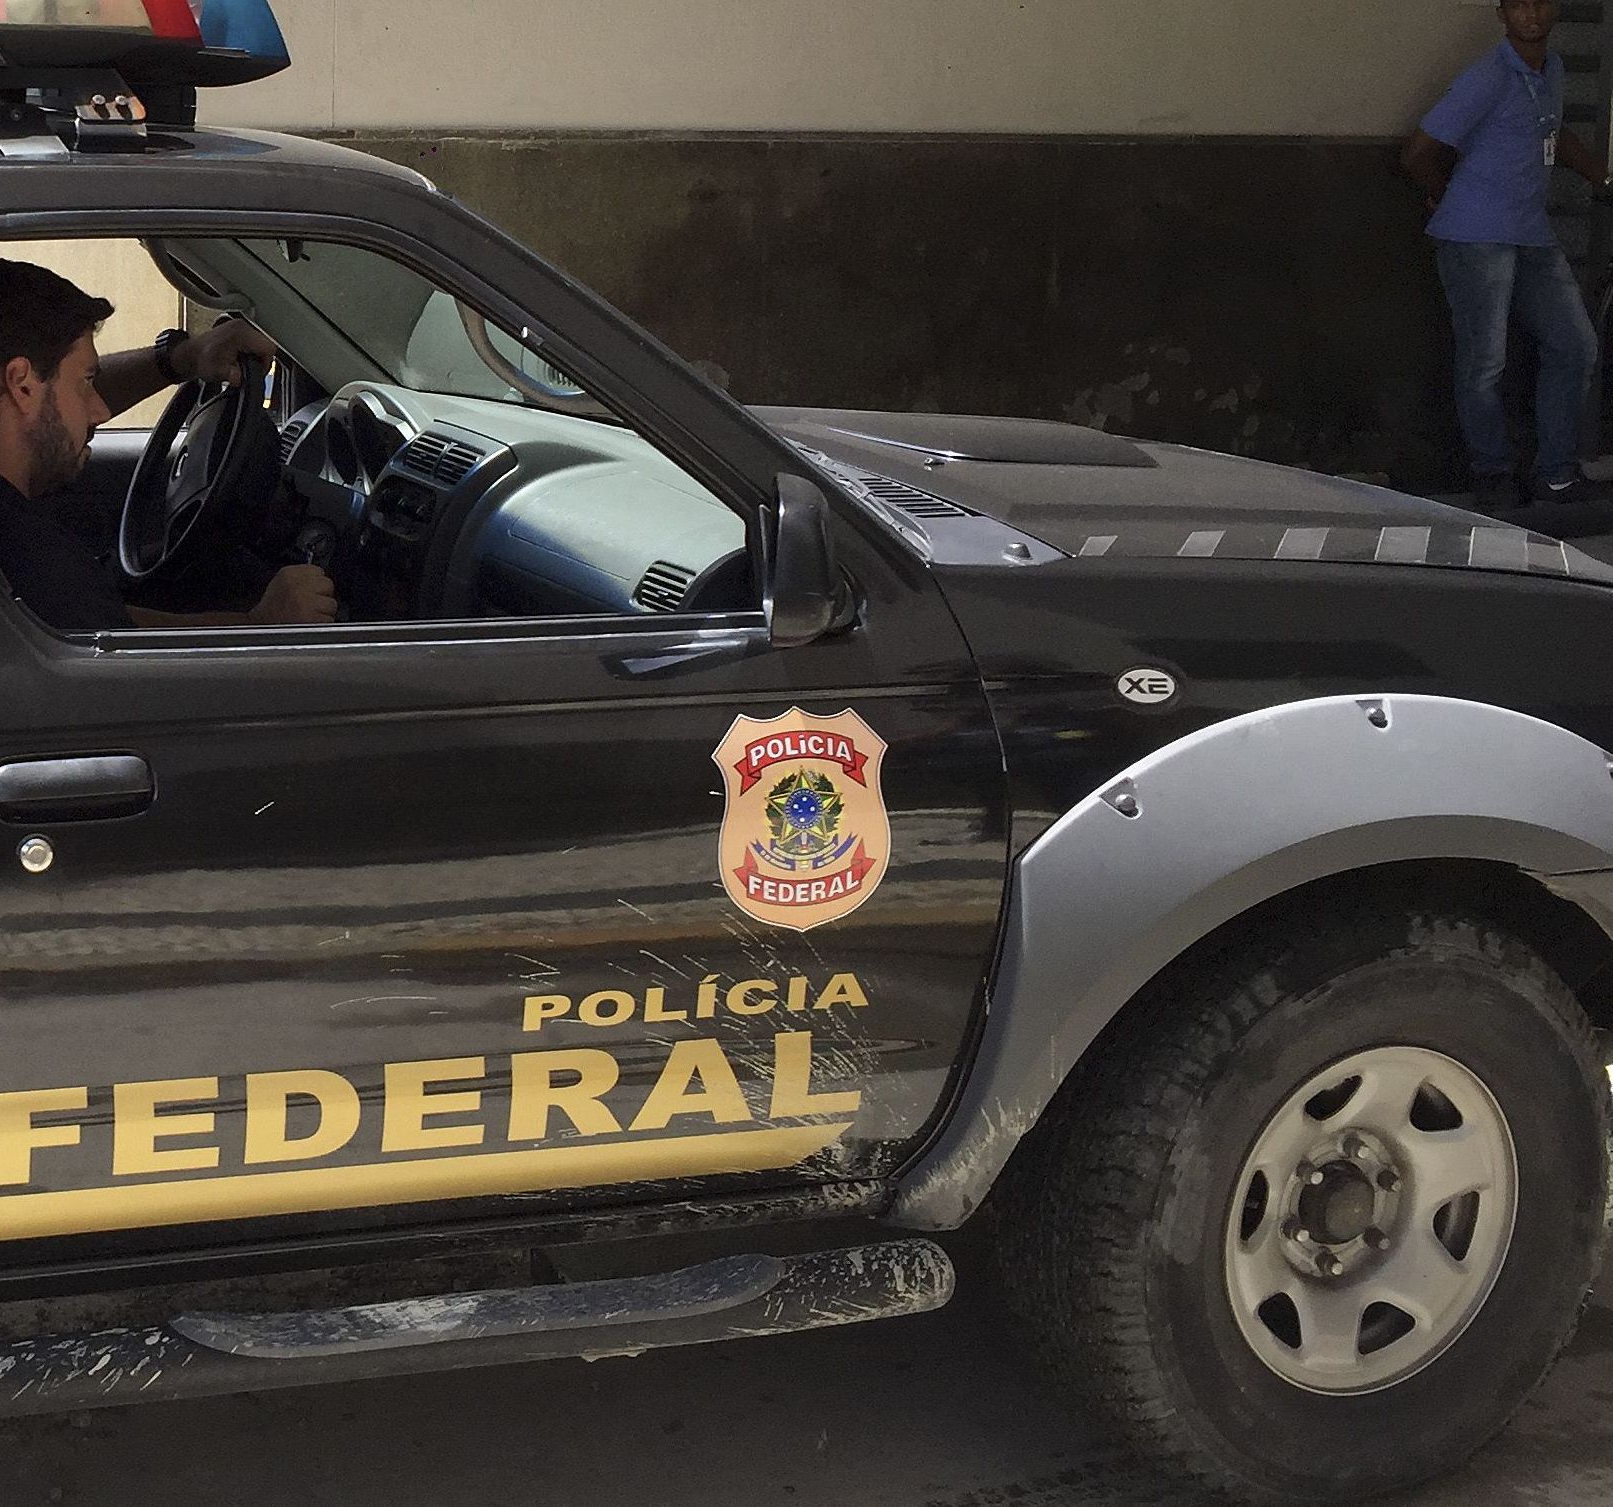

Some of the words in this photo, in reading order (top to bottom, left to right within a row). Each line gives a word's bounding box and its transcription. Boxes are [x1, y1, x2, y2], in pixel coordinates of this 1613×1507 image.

[1124, 677, 1170, 695] XE
[748, 871, 860, 903] FEDERAL
[522, 972, 869, 1032] POLÍCIA
